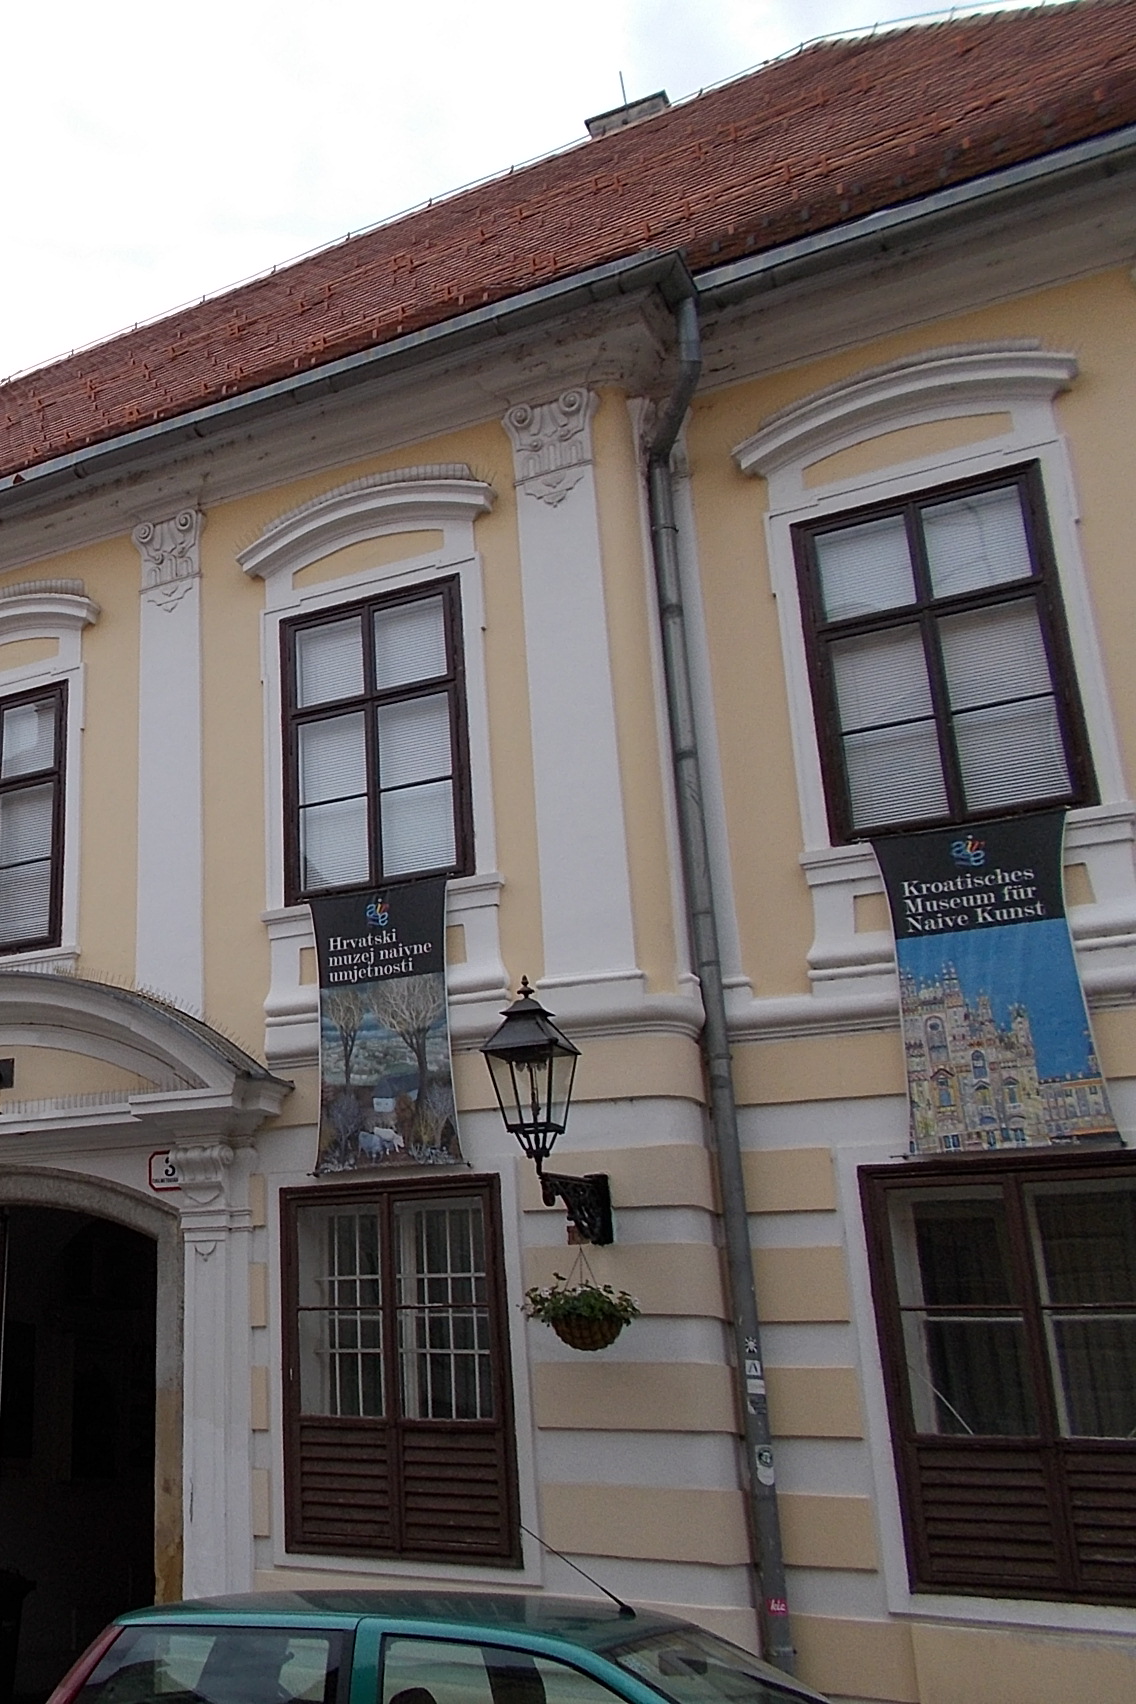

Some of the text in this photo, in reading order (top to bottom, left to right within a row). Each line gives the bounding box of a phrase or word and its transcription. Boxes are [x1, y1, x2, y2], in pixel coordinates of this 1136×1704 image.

[902, 868, 1035, 898] Kroatisches
[904, 884, 1037, 915] Museum für
[905, 900, 1046, 933] Naive Kunst
[328, 928, 397, 952] Hrvatski
[328, 942, 432, 967] muzej naivne
[328, 957, 413, 983] umjetnosti
